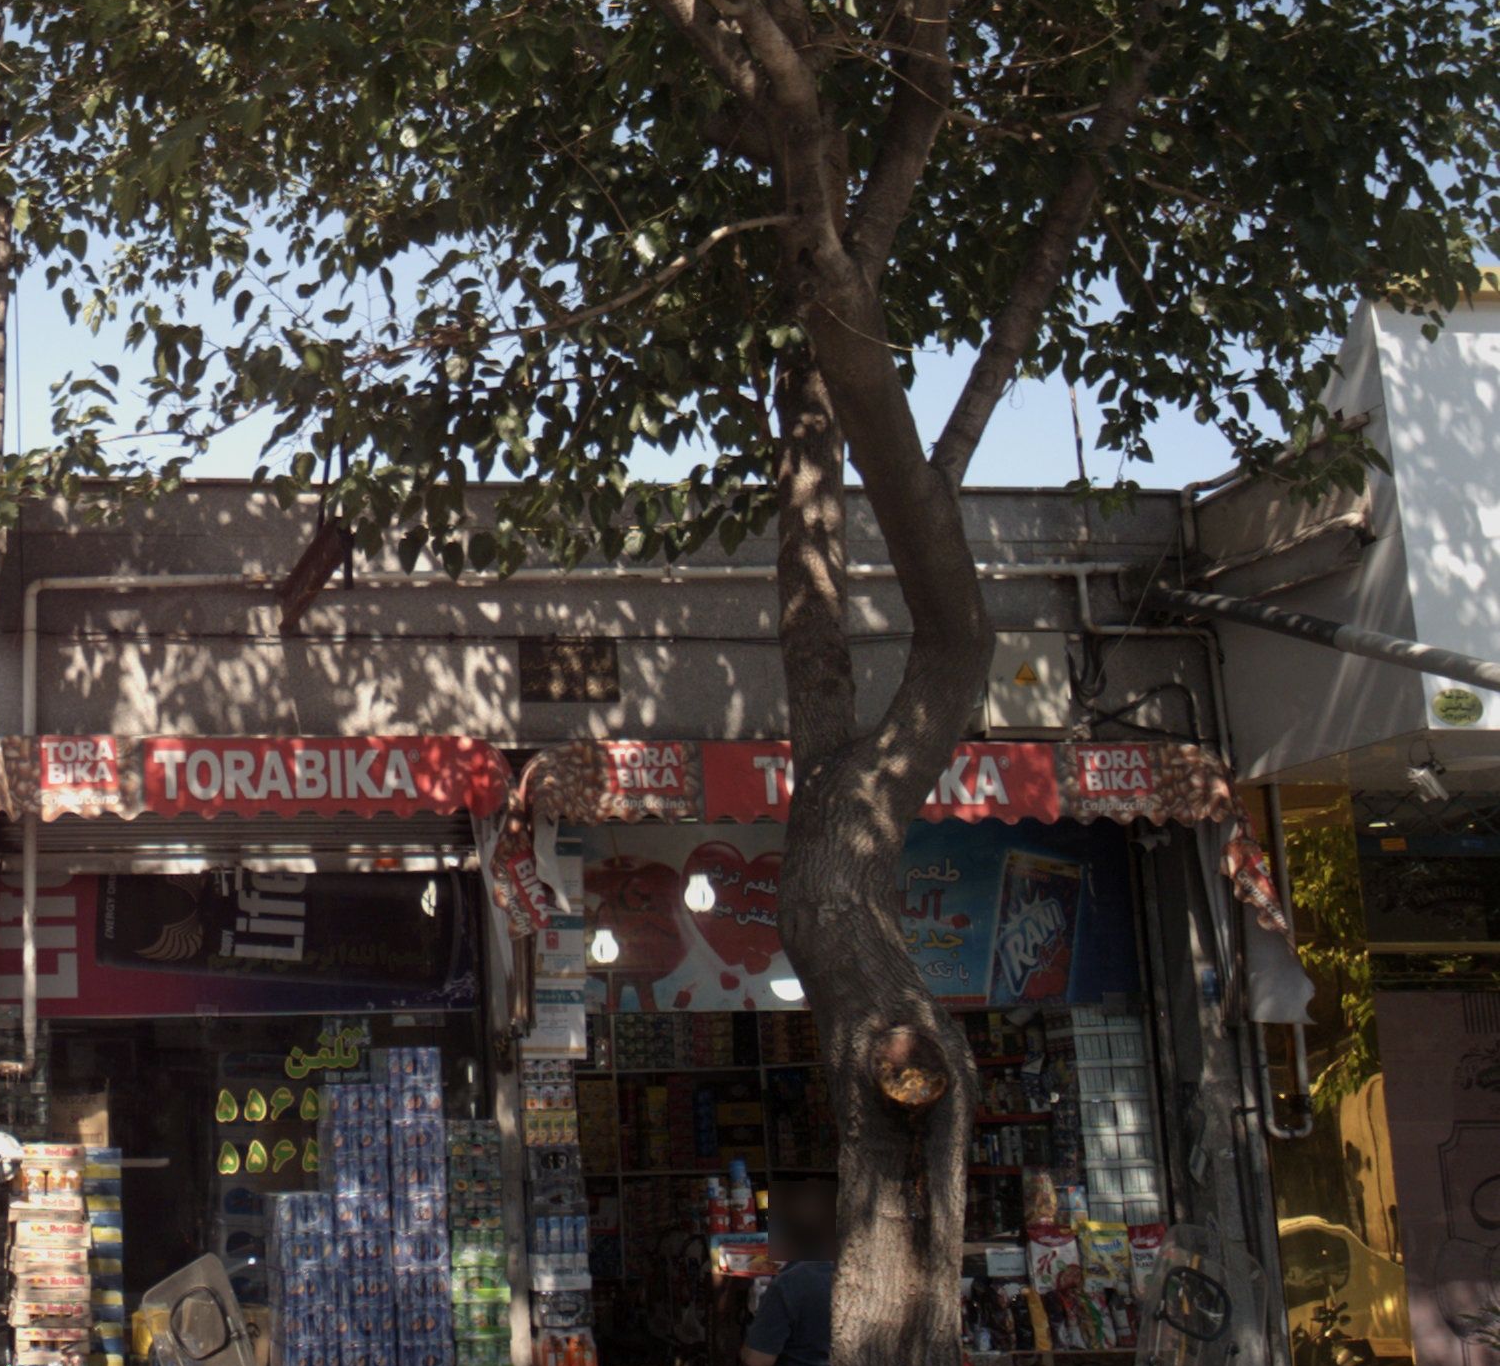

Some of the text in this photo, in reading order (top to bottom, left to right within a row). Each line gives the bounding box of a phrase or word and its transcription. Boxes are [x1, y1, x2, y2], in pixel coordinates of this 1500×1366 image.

[41, 740, 114, 762] TORA
[609, 746, 679, 768] TORA
[1078, 749, 1147, 770] TORA
[48, 762, 113, 785] BIKA
[153, 749, 418, 800] TORABIKA
[617, 768, 679, 789] BIKA
[1085, 770, 1148, 791] BIKA
[1080, 798, 1156, 813] Cappuccino
[905, 857, 963, 892] طعم
[514, 858, 549, 923] BIKA
[743, 877, 778, 896] طعم
[104, 897, 116, 939] ENERGY
[284, 1027, 362, 1079] تلفن
